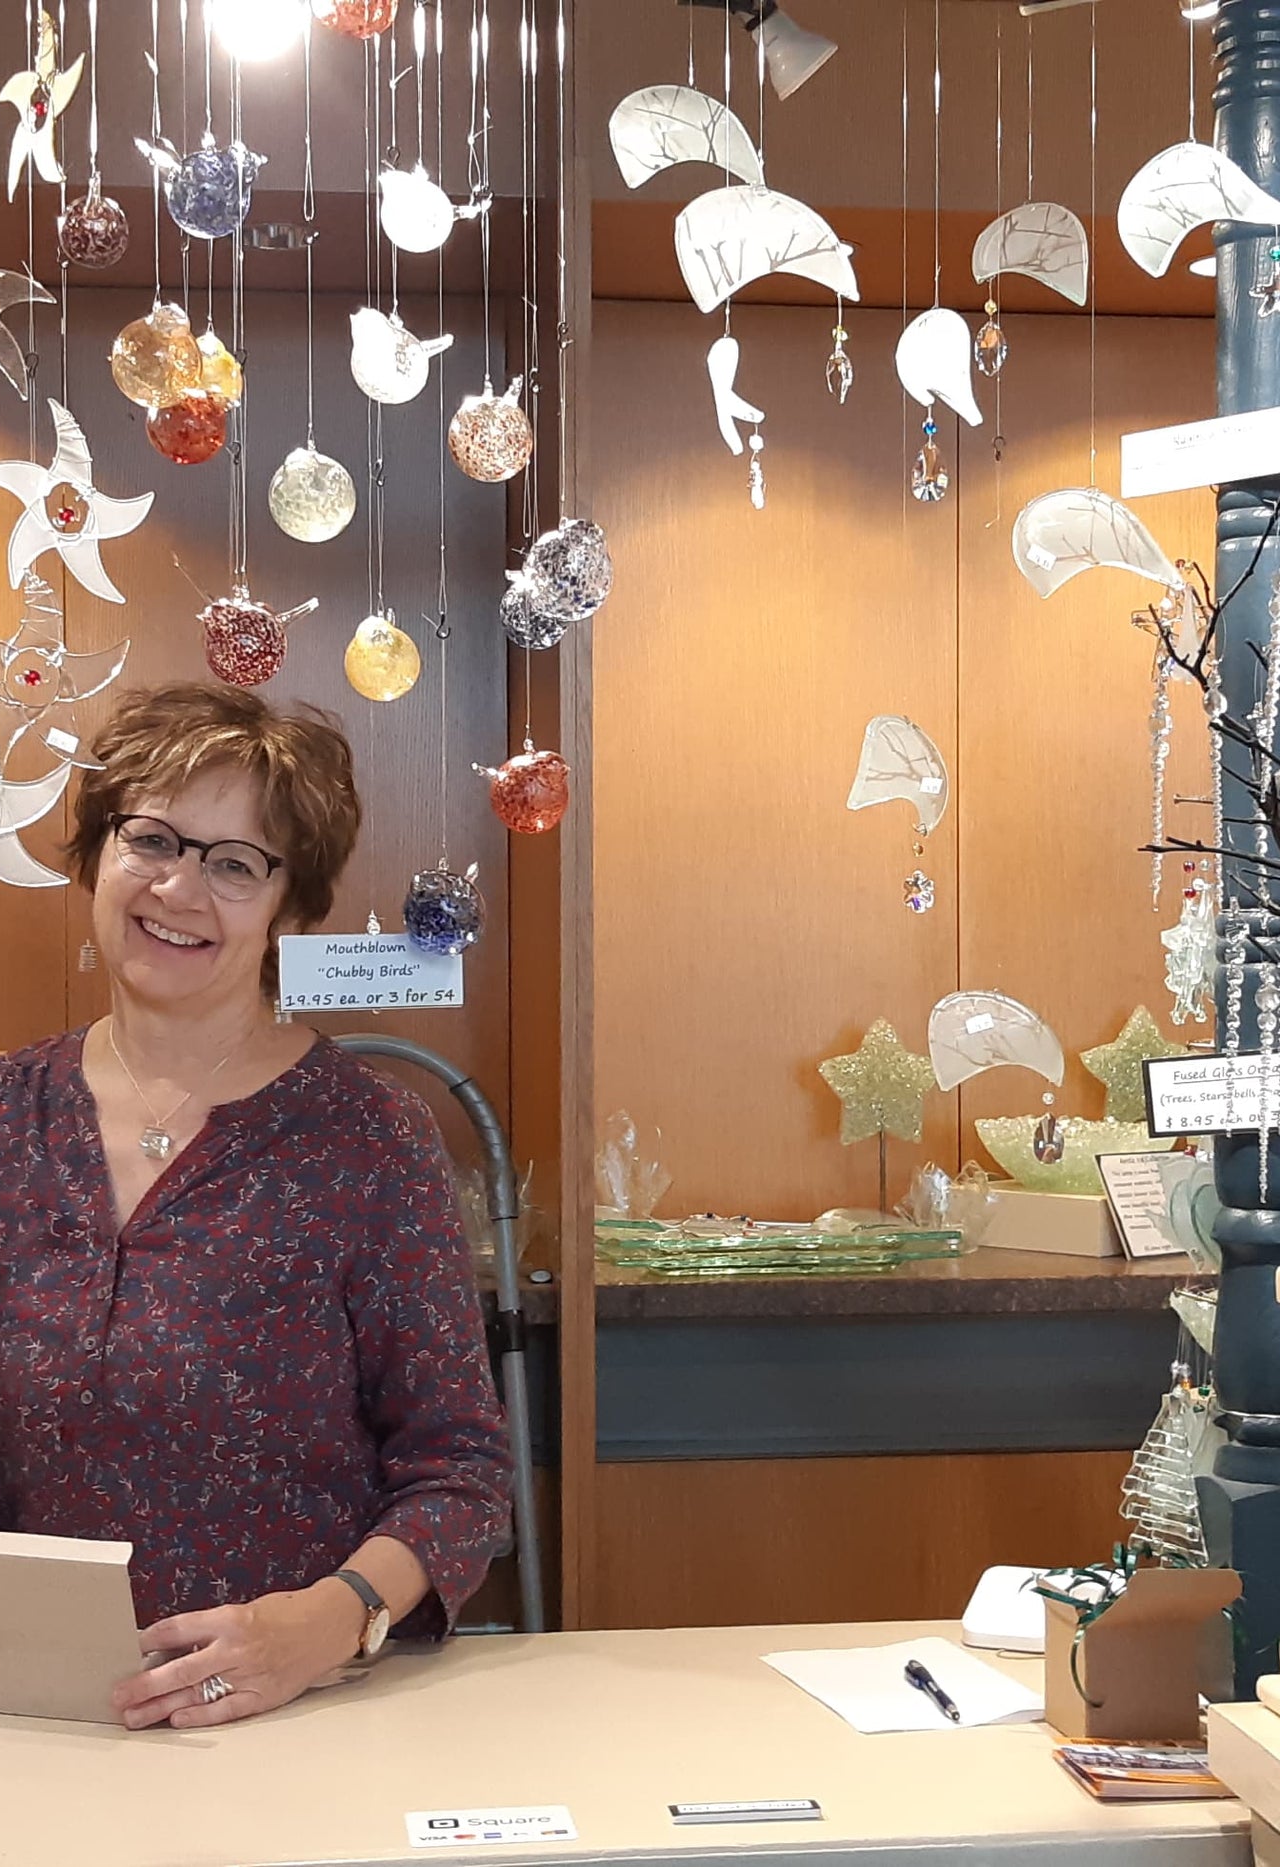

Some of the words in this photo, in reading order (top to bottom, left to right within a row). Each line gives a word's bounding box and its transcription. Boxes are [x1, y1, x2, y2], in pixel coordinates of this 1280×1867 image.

[325, 941, 406, 955] Mouthblown
[285, 993, 333, 1007] 19.95
[339, 992, 360, 1005] ea.
[366, 992, 383, 1004] or
[388, 991, 399, 1003] 3
[405, 988, 428, 1002] for
[433, 988, 455, 1001] 54
[1173, 1069, 1208, 1081] Fused
[1165, 1118, 1173, 1129] $
[1180, 1113, 1216, 1127] 8.95
[467, 1816, 551, 1826] Square
